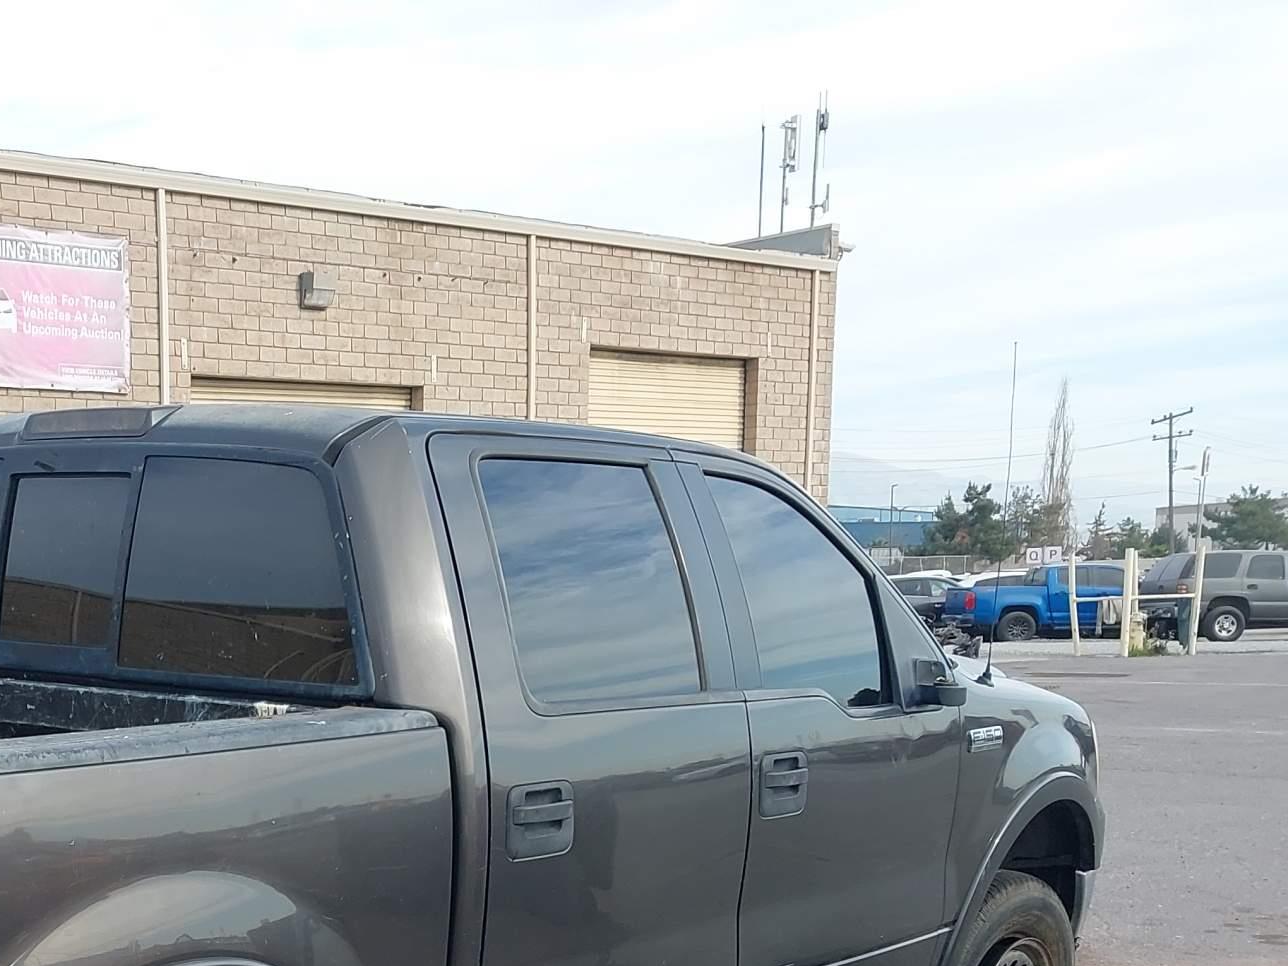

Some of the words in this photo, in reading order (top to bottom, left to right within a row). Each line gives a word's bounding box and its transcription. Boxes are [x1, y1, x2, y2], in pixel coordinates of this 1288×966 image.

[29, 242, 119, 269] ATTRACTIONS
[22, 290, 57, 305] Watch
[61, 293, 80, 307] For
[82, 295, 117, 310] These
[22, 306, 71, 321] Vehicles
[74, 310, 88, 322] At
[92, 311, 106, 324] An
[22, 321, 78, 340] Upcoming
[1029, 550, 1039, 561] Q
[1049, 549, 1058, 560] P
